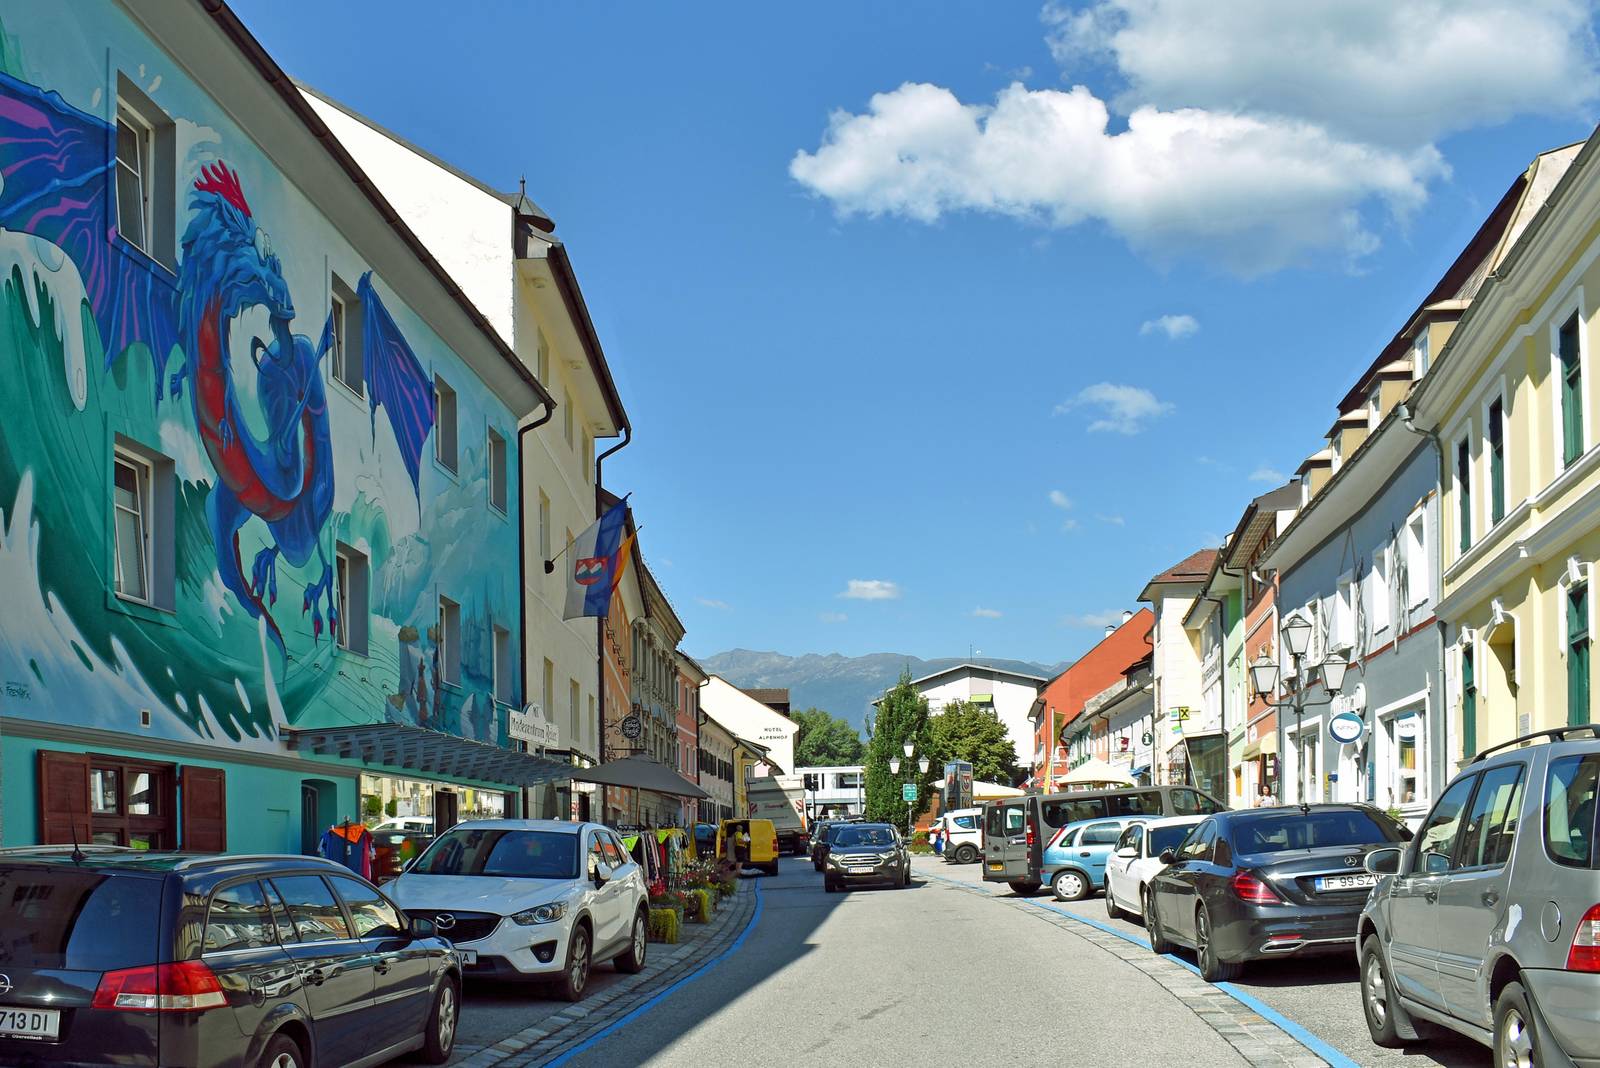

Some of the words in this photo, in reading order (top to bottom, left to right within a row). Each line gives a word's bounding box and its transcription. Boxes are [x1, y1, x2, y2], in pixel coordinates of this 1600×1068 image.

[1325, 877, 1335, 888] IF
[1340, 876, 1354, 887] 99
[31, 1013, 48, 1032] DI
